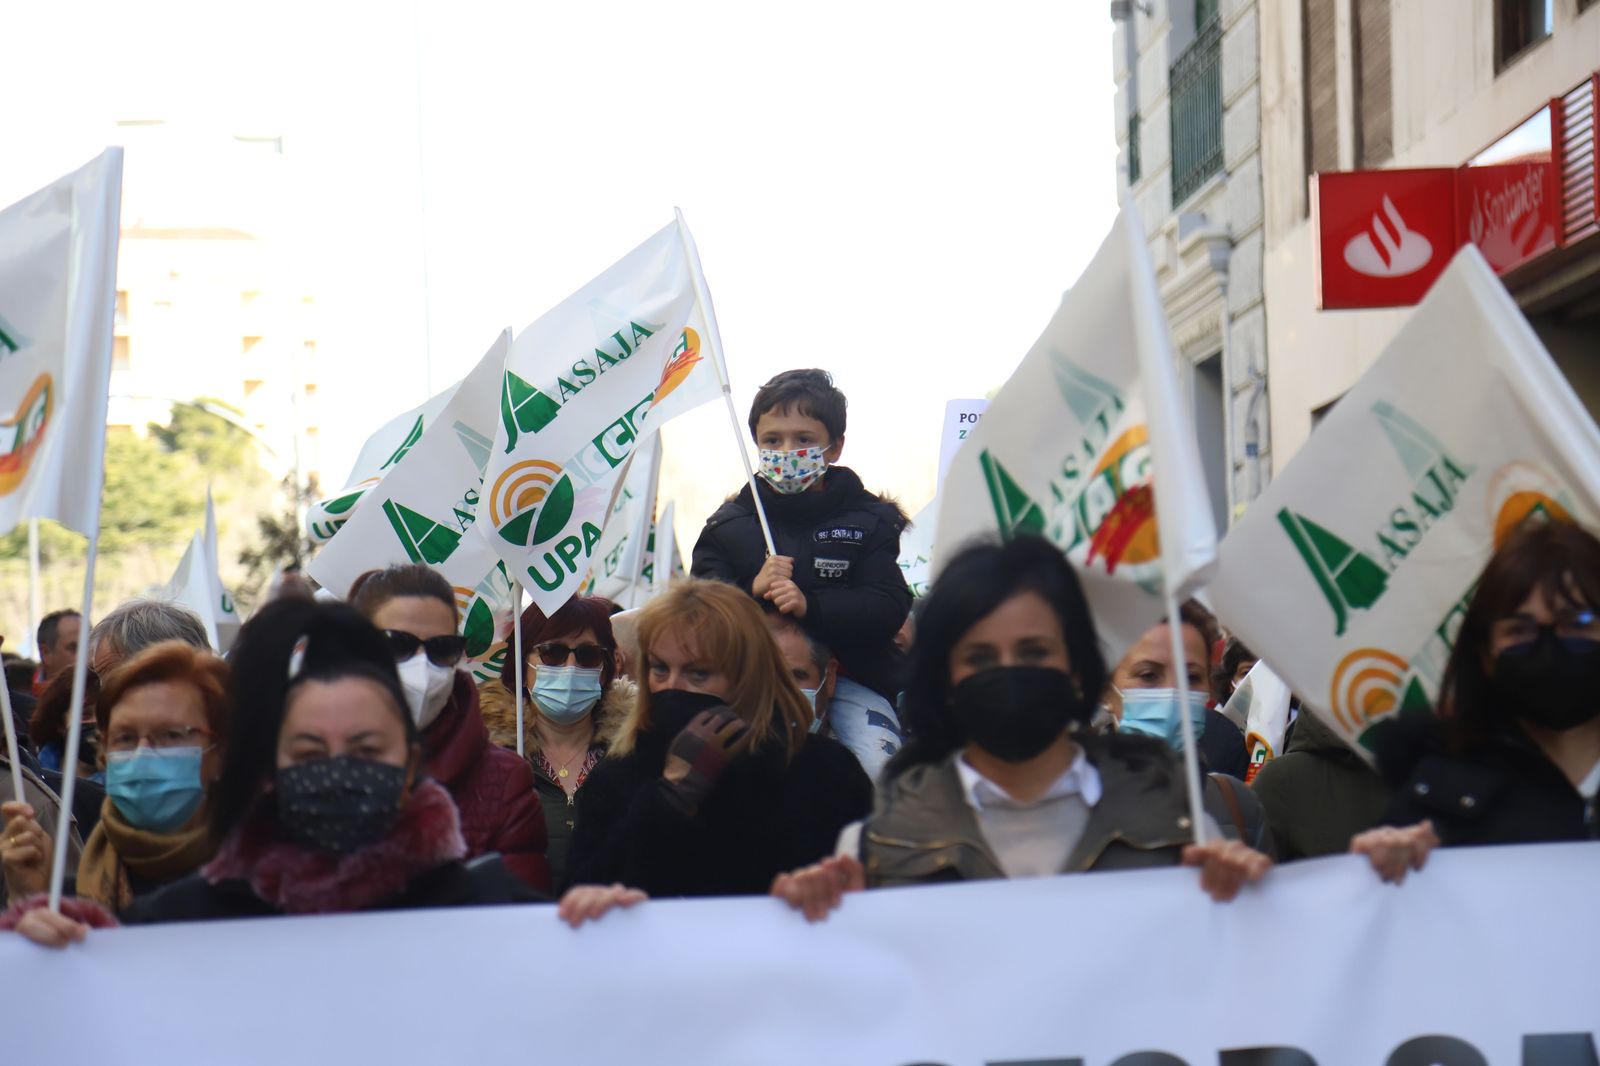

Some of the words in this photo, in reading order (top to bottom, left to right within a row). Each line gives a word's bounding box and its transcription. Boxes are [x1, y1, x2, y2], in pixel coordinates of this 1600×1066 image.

[1485, 164, 1544, 242] Santander
[557, 321, 655, 404] ASAJA
[1376, 454, 1468, 571] ASAJA
[527, 521, 602, 592] UPA
[817, 561, 846, 569] LONDON
[820, 569, 843, 578] LTD
